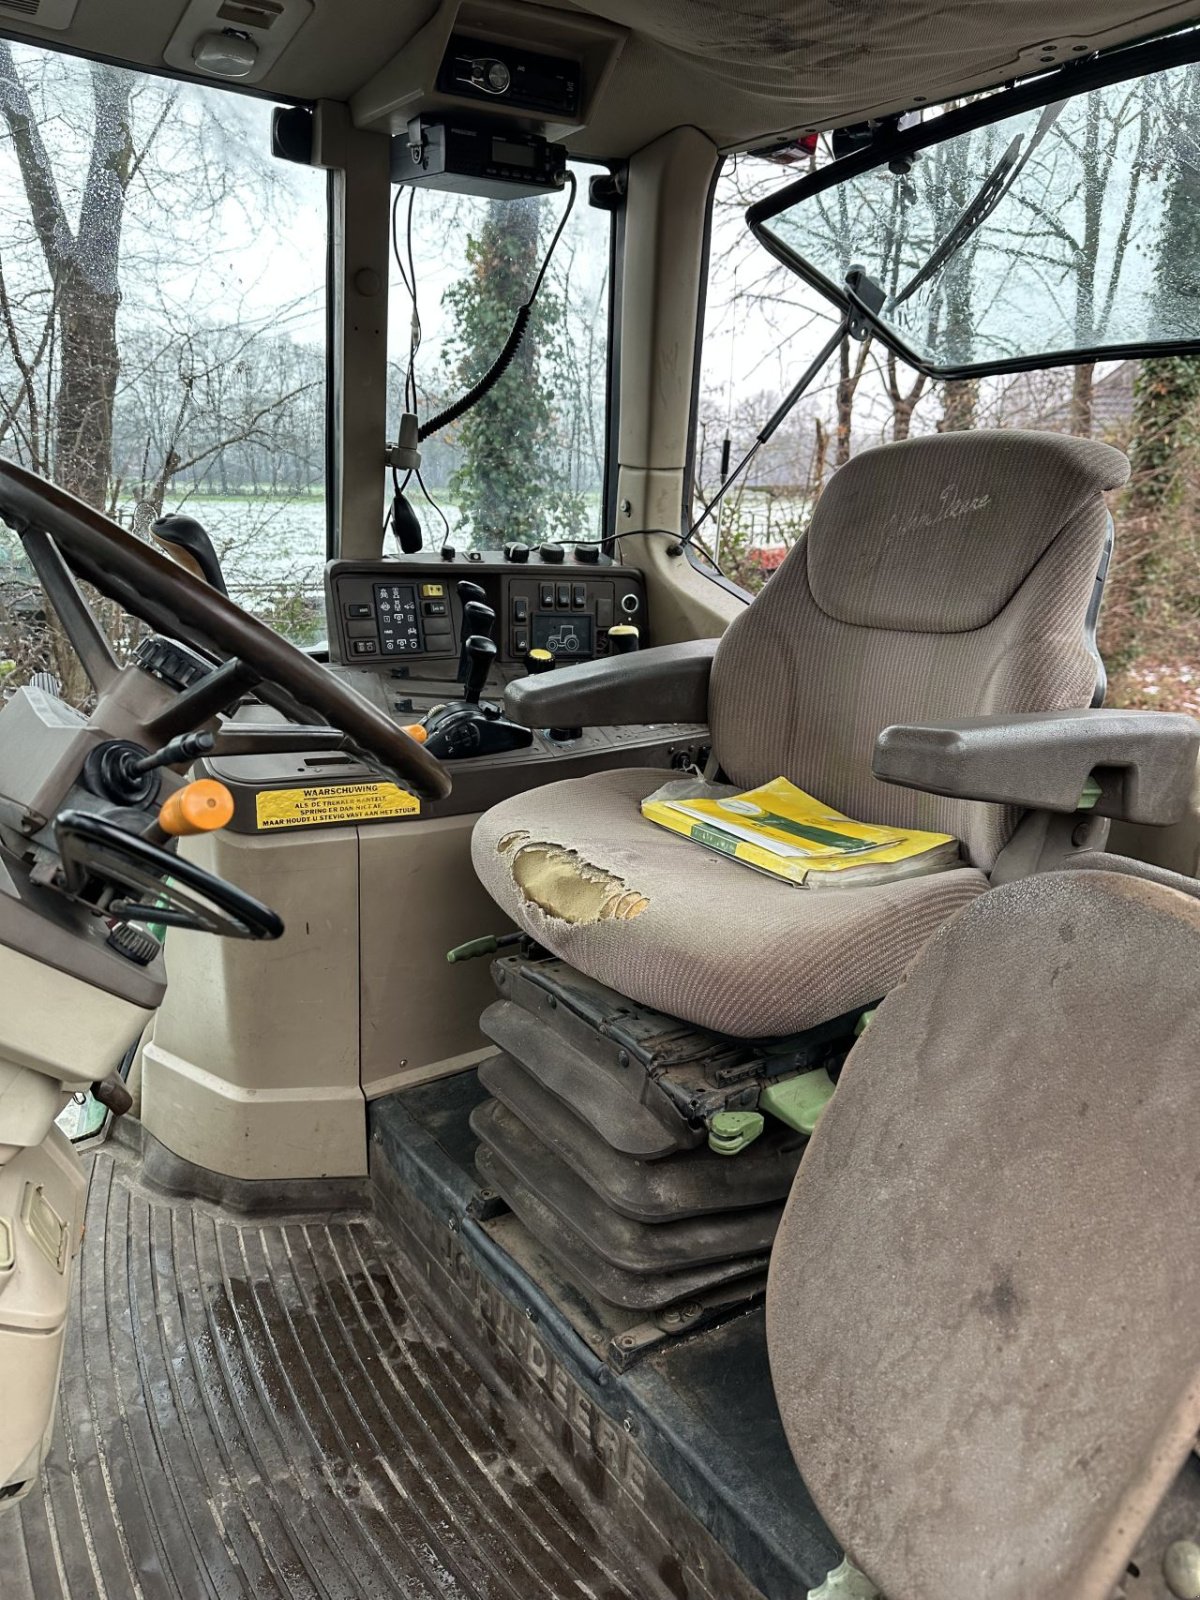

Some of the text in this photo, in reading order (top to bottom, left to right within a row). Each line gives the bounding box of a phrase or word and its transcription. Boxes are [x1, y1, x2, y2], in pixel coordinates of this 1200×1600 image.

[303, 785, 378, 797] WAARSCHUWING
[262, 819, 284, 827] MAAR
[286, 816, 311, 825] HOUDT
[319, 812, 345, 821] STEVIG
[346, 811, 363, 819] VAST
[364, 809, 379, 817] AAN
[379, 808, 393, 816] HET
[394, 806, 416, 814] STUUR
[300, 808, 328, 816] SPRING
[528, 1331, 647, 1502] DEERE
